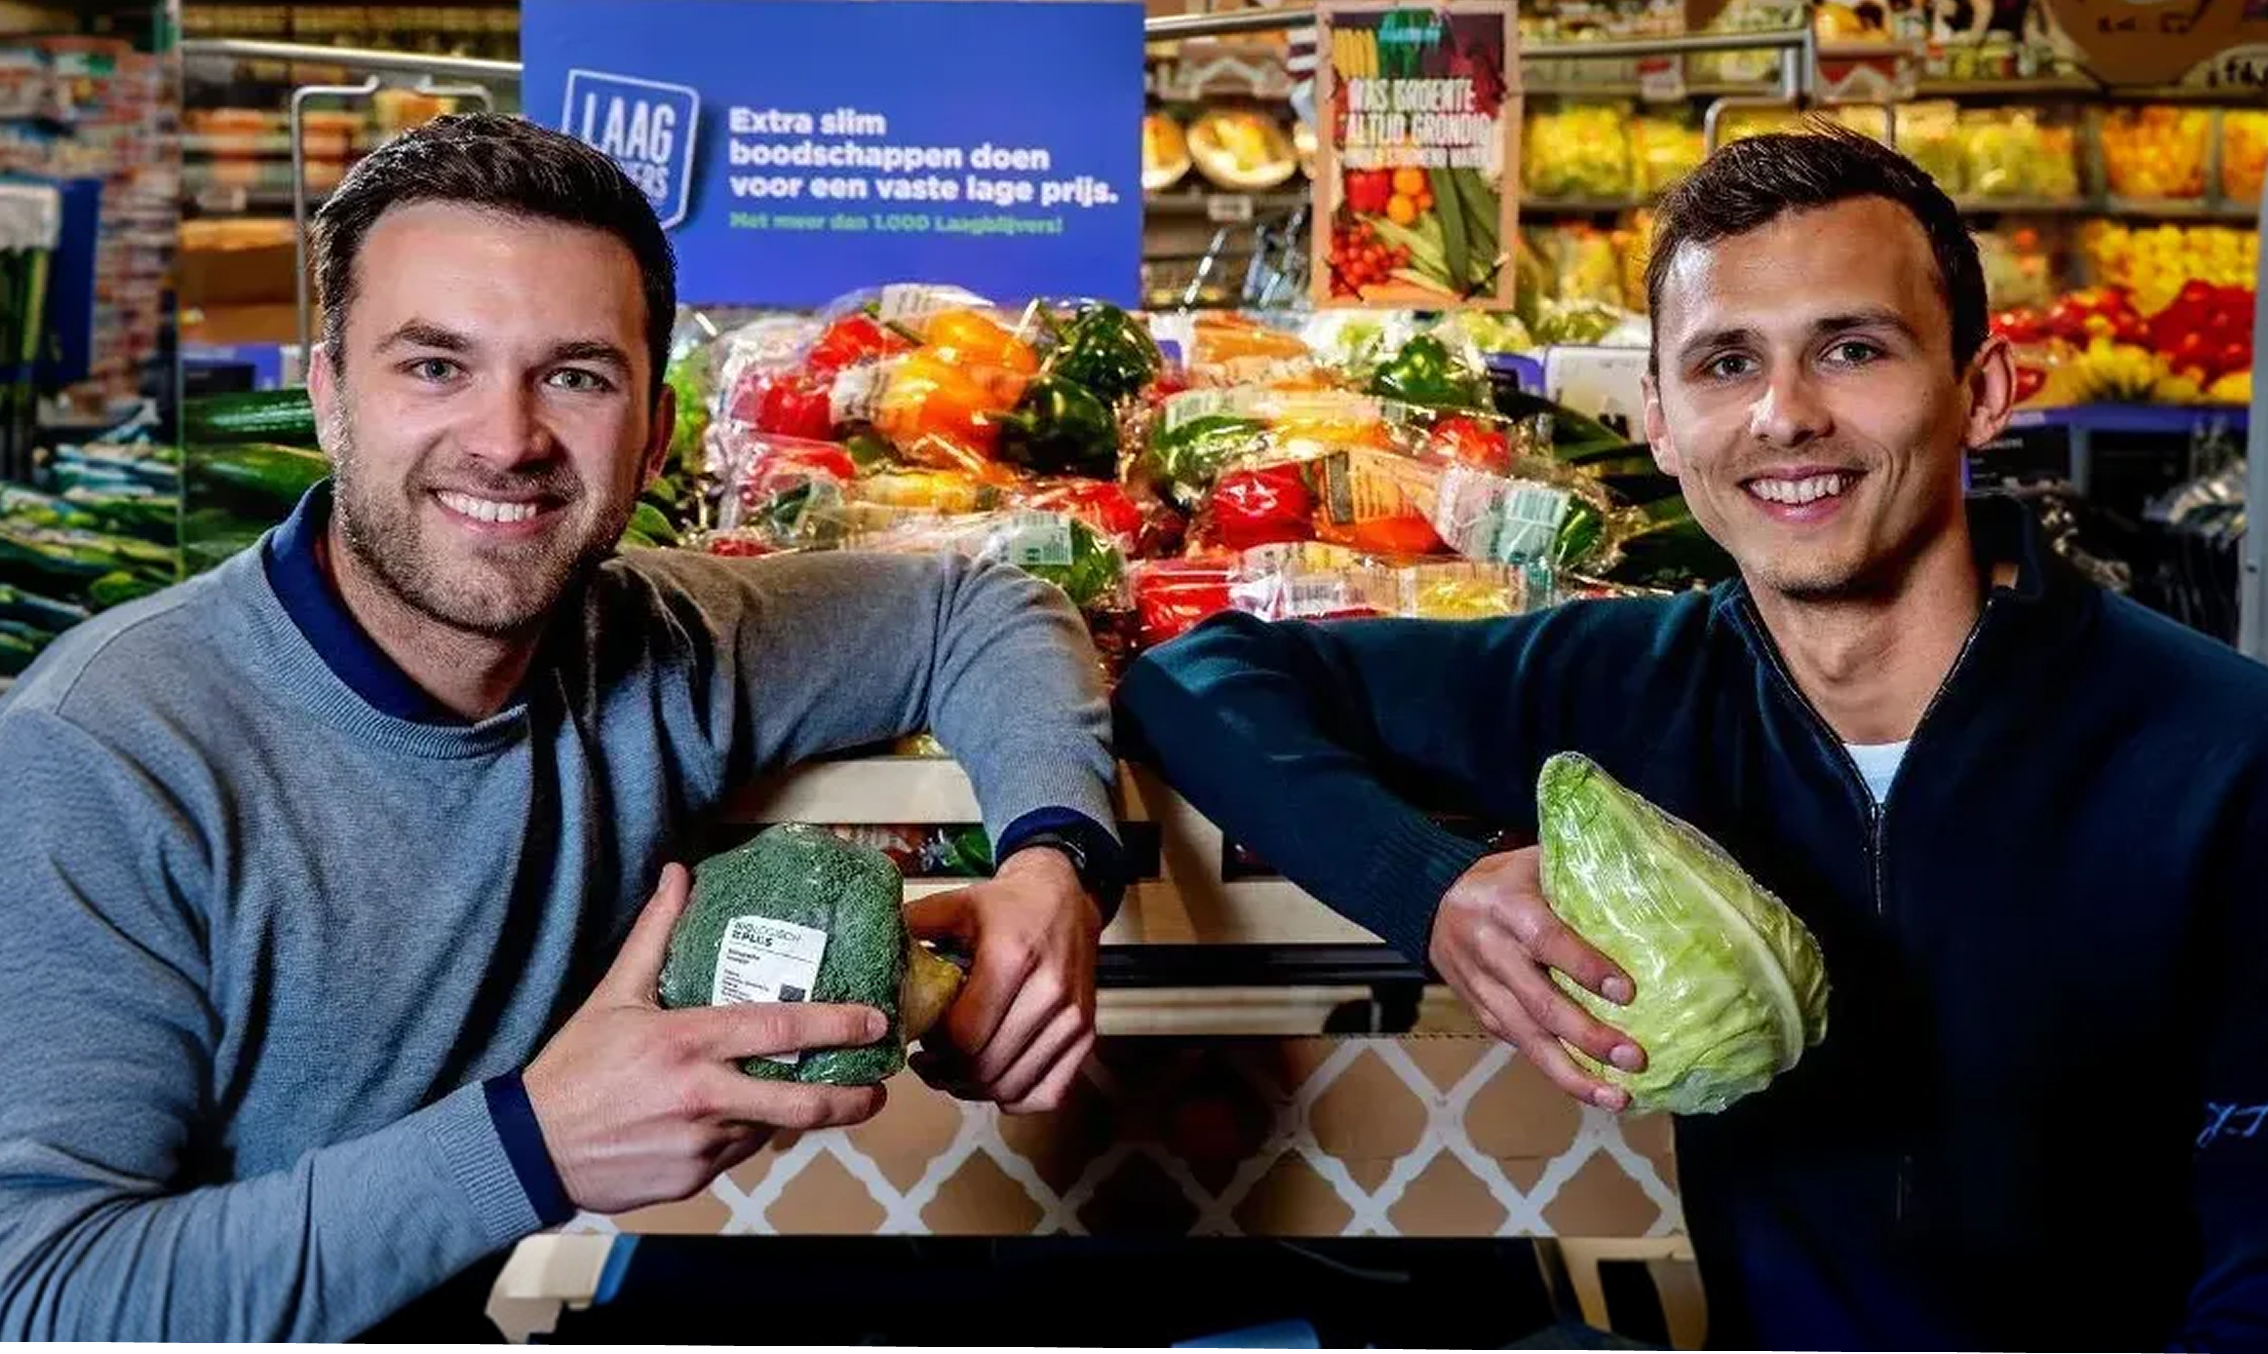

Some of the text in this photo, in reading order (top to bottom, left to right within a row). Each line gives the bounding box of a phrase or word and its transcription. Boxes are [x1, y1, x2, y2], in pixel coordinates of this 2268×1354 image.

[581, 92, 676, 165] LAAG
[729, 107, 887, 135] Extra slim
[729, 138, 1051, 171] boodschappen doen
[729, 174, 1119, 207] voor een vaste lage prijs.
[830, 213, 868, 231] dan
